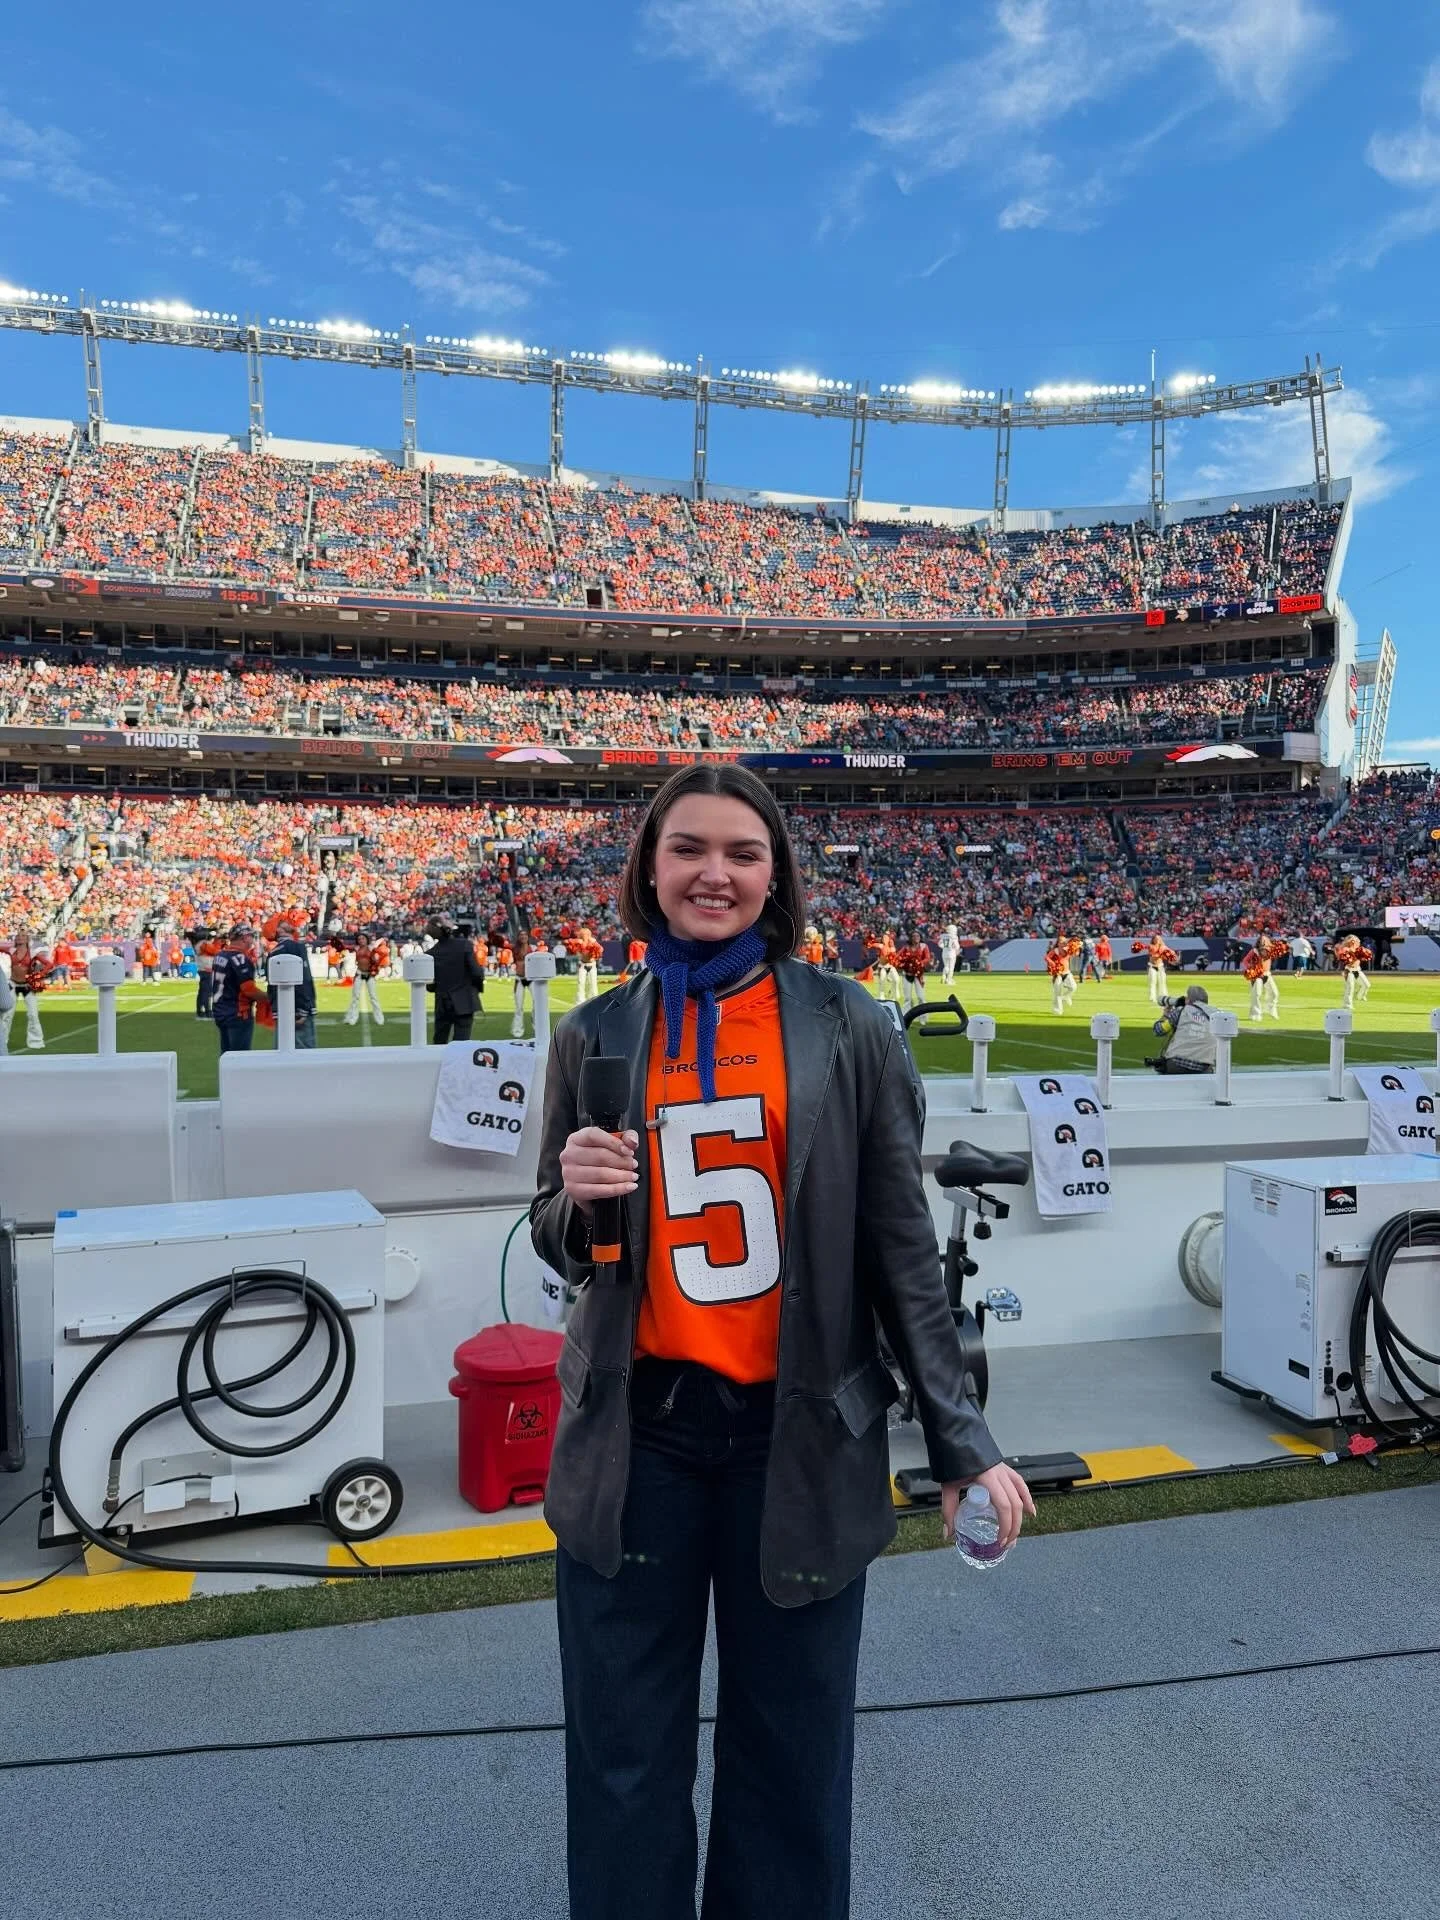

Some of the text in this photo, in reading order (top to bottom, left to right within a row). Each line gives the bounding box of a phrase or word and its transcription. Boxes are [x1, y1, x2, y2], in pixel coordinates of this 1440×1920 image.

[104, 584, 151, 592] COUNTDOWN
[220, 590, 258, 601] 15:54
[308, 595, 340, 604] FOLEY
[123, 733, 200, 748] THUNDER
[302, 741, 364, 755] BRING
[411, 745, 452, 759] OUT
[603, 751, 658, 764] BRING
[701, 753, 738, 765] OUT
[844, 754, 906, 768] THUNDER
[992, 754, 1047, 767] BRING
[1092, 750, 1132, 764] OUT
[232, 953, 245, 966] 17
[662, 1054, 758, 1075] BROCOS
[467, 1112, 522, 1133] GATO
[655, 1094, 783, 1306] 5
[508, 1427, 548, 1440] BIOHAZARD
